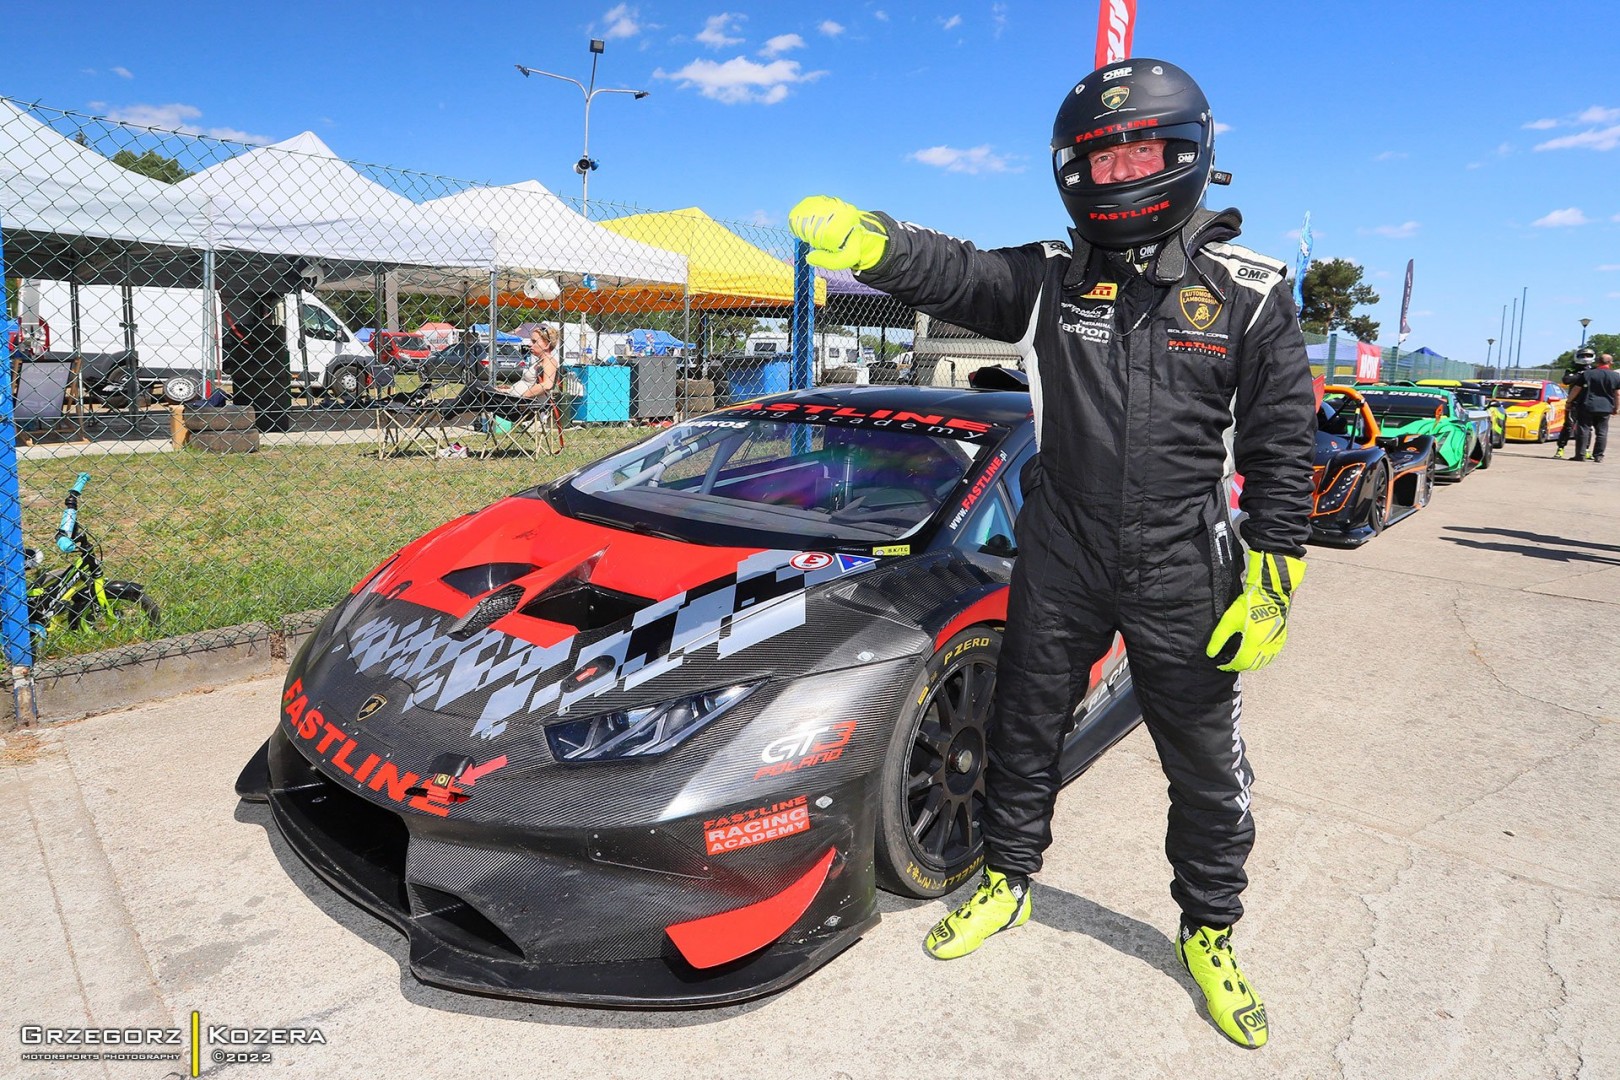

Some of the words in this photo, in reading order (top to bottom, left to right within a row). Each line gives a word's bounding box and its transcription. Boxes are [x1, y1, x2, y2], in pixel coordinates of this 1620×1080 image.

[1103, 67, 1132, 81] OMP
[1075, 118, 1159, 143] FASTLINE
[1090, 200, 1170, 220] FASTLINE
[1237, 267, 1269, 280] OMP
[1168, 340, 1227, 354] FASTLINE
[806, 414, 985, 439] academy
[949, 449, 1008, 531] www.FASTLINE.pl
[803, 554, 824, 565] E
[1249, 605, 1279, 621] OMP
[943, 651, 953, 666] P
[954, 637, 990, 657] ZERO
[284, 677, 464, 818] FASTLINE
[761, 720, 857, 763] GT3
[753, 748, 843, 780] POLAND
[704, 794, 807, 830] FASTLINE
[708, 807, 808, 842] RACING
[711, 821, 806, 852] ACADEMY
